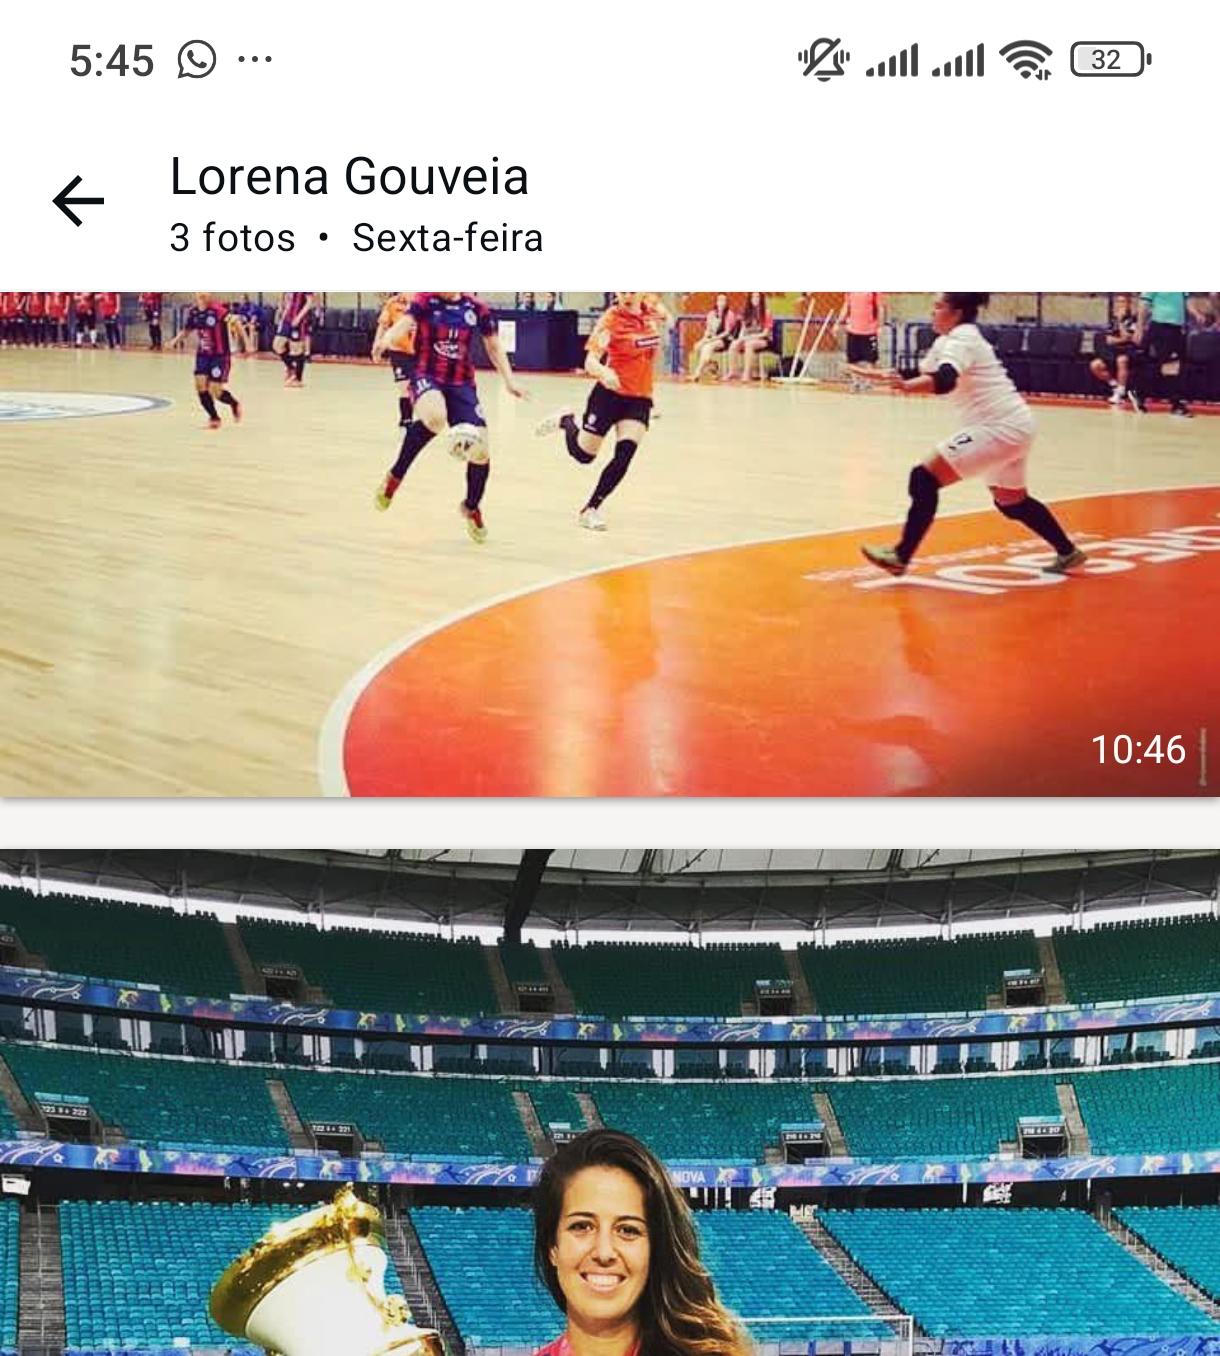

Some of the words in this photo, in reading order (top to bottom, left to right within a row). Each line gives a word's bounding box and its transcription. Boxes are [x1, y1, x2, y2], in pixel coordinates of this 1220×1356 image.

[70, 43, 154, 77] 5:45
[1091, 49, 1121, 70] 32
[172, 156, 328, 196] Lorena
[345, 155, 528, 196] Gouveia
[170, 222, 189, 252] 3
[202, 220, 295, 252] fotos
[353, 220, 543, 252] Sexta-feira
